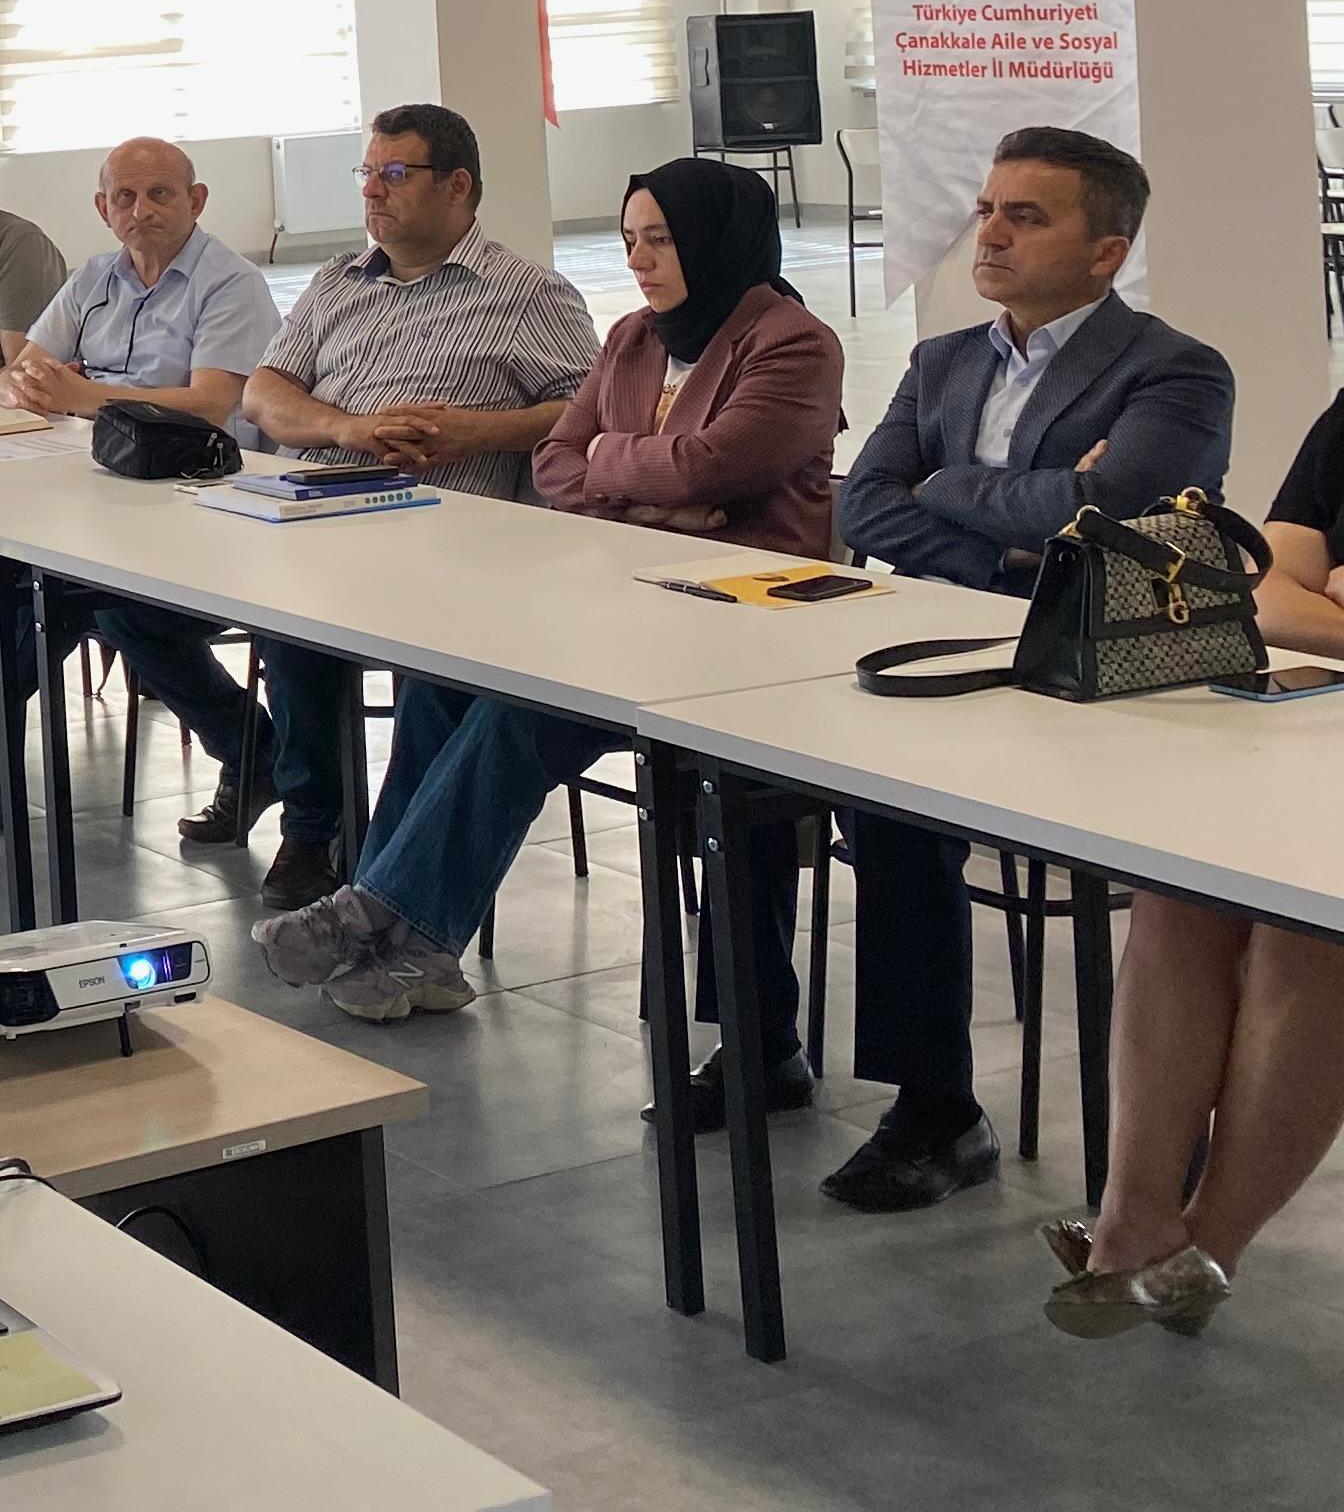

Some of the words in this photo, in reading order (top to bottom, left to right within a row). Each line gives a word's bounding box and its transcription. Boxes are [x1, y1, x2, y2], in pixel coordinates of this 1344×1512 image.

[912, 4, 977, 25] Türkiye
[982, 3, 1099, 25] Cumhuriyeti
[895, 31, 986, 53] Çanakkale
[991, 32, 1026, 49] Aile
[1033, 37, 1054, 49] ve
[1060, 32, 1118, 53] Sosyal
[903, 60, 988, 77] Hizmetler
[992, 57, 1003, 78] İl
[1009, 60, 1114, 83] Müdürlüğü
[79, 976, 105, 989] EPSON
